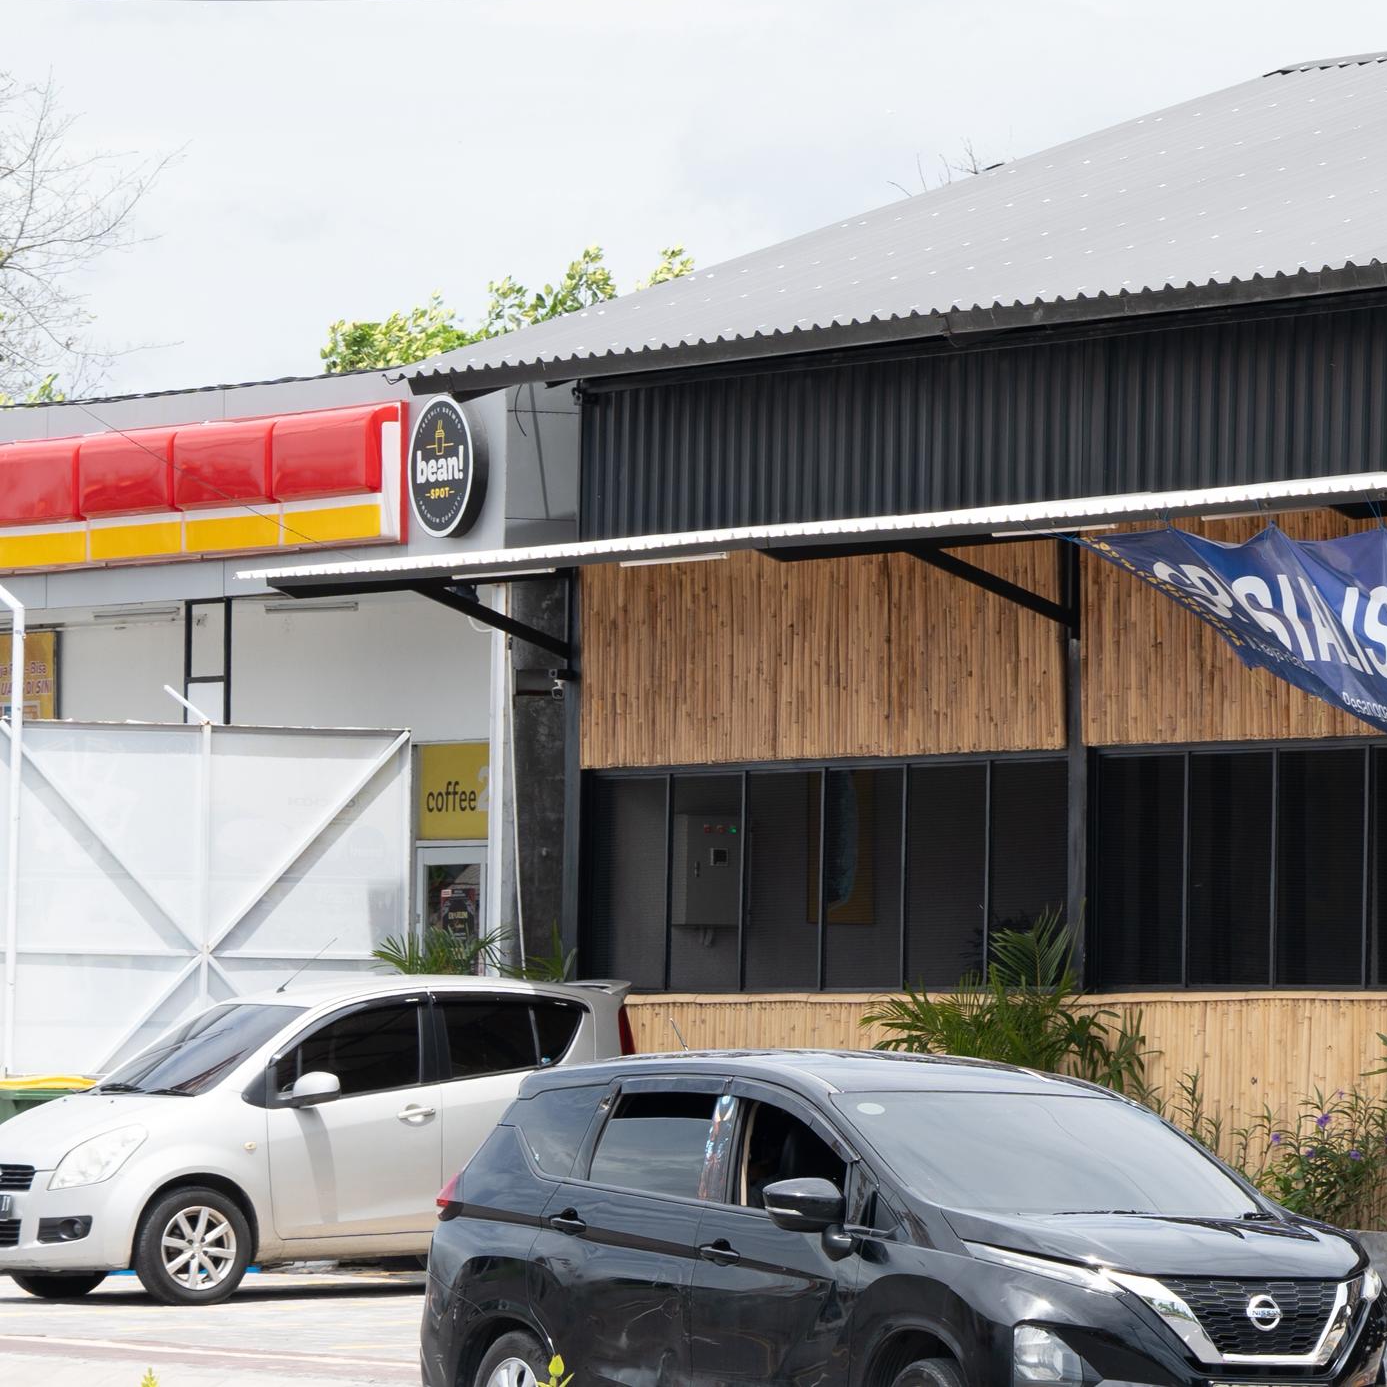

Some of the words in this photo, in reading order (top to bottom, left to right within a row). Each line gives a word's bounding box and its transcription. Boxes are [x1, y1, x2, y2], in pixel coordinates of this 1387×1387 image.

[416, 444, 464, 484] bean!
[430, 487, 450, 500] SPOT
[426, 781, 477, 813] coffee
